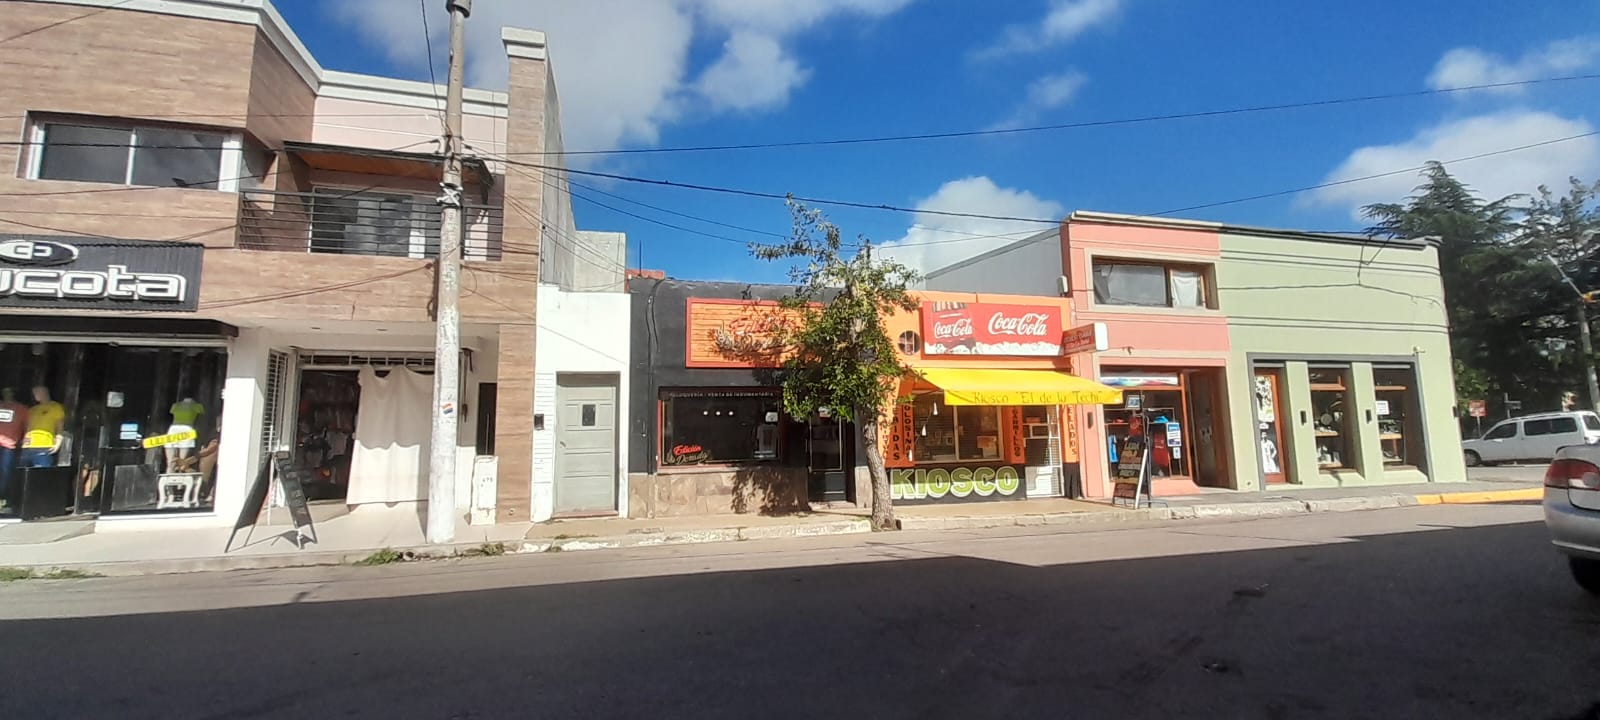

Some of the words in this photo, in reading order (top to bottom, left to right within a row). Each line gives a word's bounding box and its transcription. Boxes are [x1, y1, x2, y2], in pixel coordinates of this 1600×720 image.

[934, 318, 973, 339] Coca-Cola
[988, 312, 1050, 336] Coca-Cola
[973, 391, 1009, 403] Kiosco
[1039, 391, 1051, 403] de
[890, 465, 1019, 500] KIOSCO
